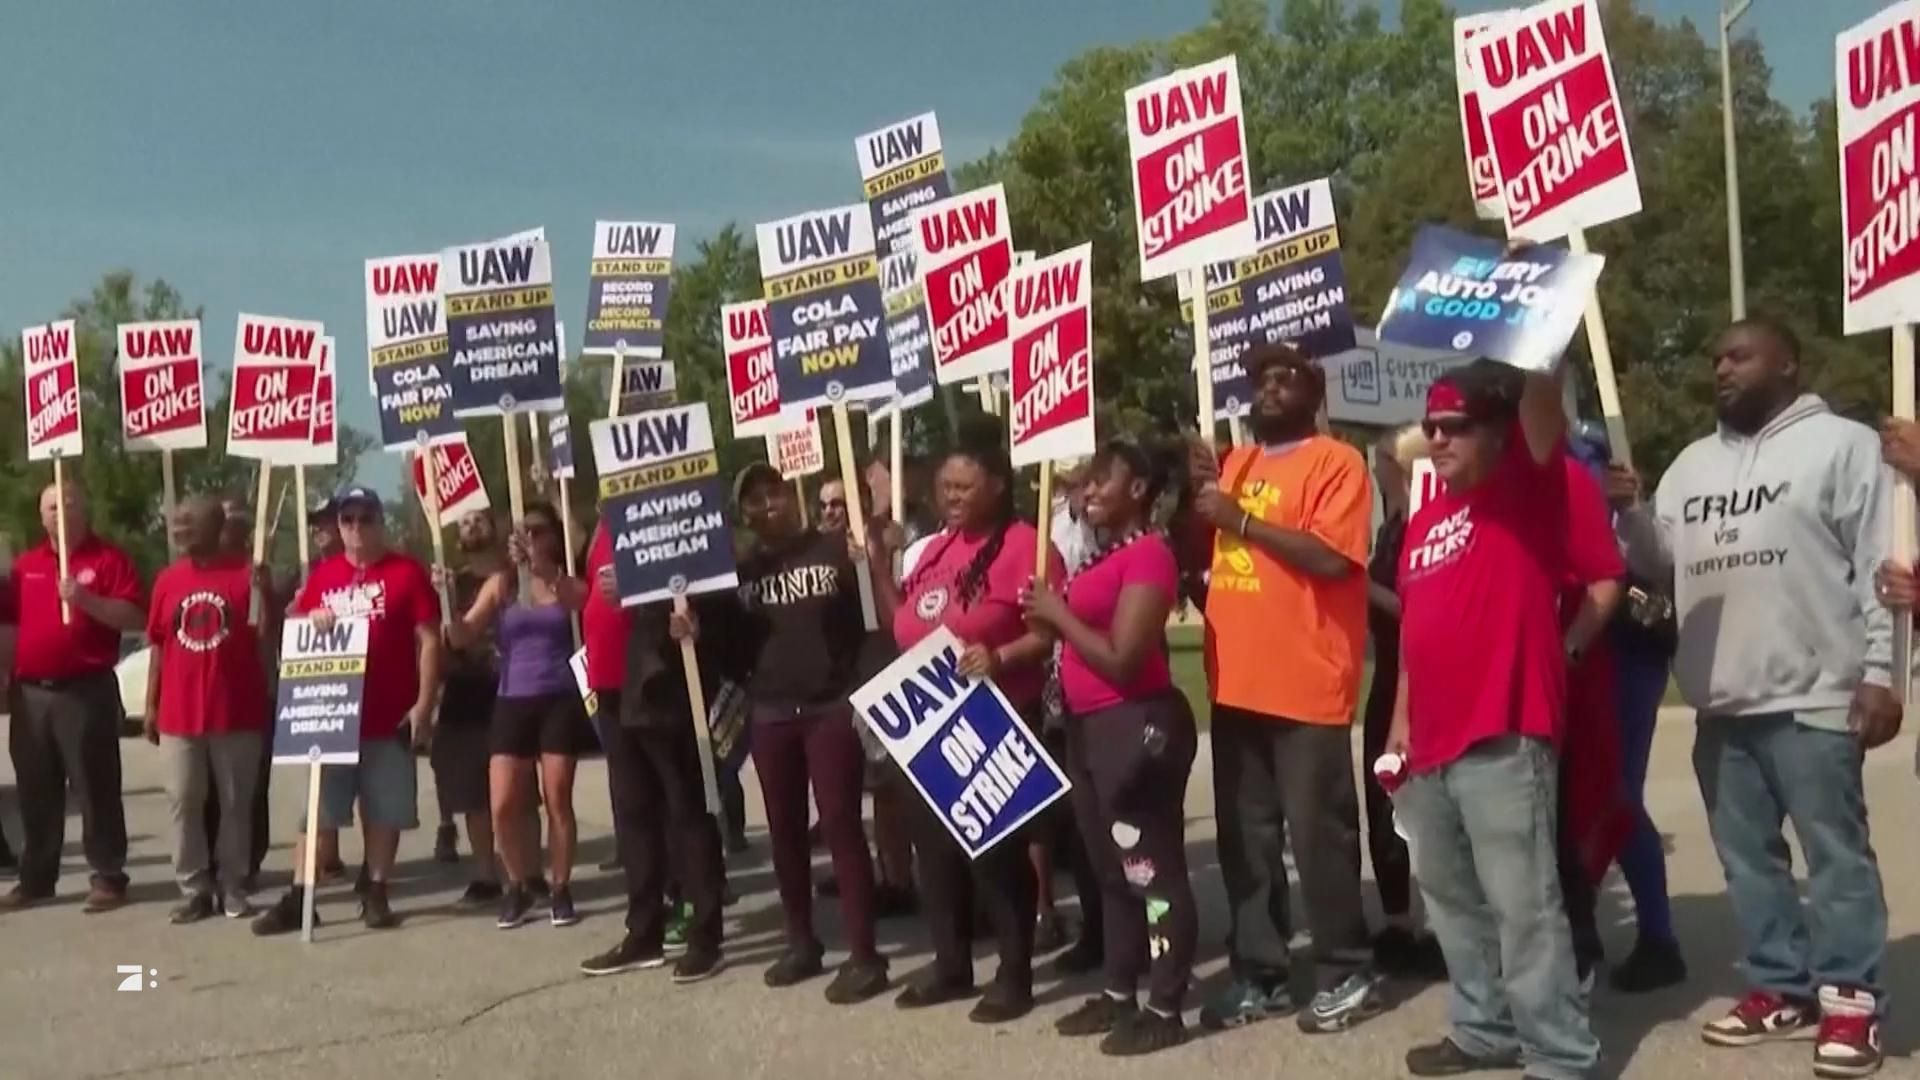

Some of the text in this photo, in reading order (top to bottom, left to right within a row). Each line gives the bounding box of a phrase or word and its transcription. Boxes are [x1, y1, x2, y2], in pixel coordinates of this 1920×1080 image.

[1480, 4, 1586, 89] UAW
[1137, 71, 1227, 136] UAW
[1522, 80, 1570, 150] ON
[869, 120, 922, 169] UAW
[1505, 99, 1620, 222] STRIKE
[1872, 112, 1915, 202] ON
[869, 158, 940, 194] STAND UP
[1166, 134, 1204, 192] ON
[882, 186, 936, 217] SAVING
[1143, 155, 1244, 251] STRIKE
[607, 226, 661, 255] UAW
[776, 212, 851, 265] UAW
[921, 198, 997, 253] UAW
[1850, 177, 1920, 294] STRI
[459, 246, 534, 286] UAW
[595, 262, 666, 273] STAND UP
[1241, 234, 1331, 274] STAND UP
[1452, 256, 1553, 281] EVERY
[373, 262, 438, 295] UAW
[602, 282, 653, 294] RECORD
[771, 260, 870, 298] STAND UP
[949, 254, 983, 306] ON
[1014, 259, 1083, 319] UAW
[1257, 266, 1325, 302] SAVING
[1415, 271, 1557, 306] AUTO JO
[451, 290, 547, 314] STAND UP
[600, 306, 651, 319] RECORD
[601, 293, 653, 305] PROFITS
[792, 295, 859, 326] COLA
[1249, 286, 1345, 332] AMERICAN
[1425, 298, 1501, 321] GOOD
[383, 303, 437, 337] UAW
[465, 319, 537, 341] SAVING
[588, 319, 662, 332] CONTRACTS
[729, 308, 769, 341] UA
[29, 328, 69, 364] UAW
[126, 328, 193, 359] UAW
[244, 323, 315, 360] UAW
[377, 343, 425, 364] STAND
[453, 340, 554, 368] AMERICAN
[777, 317, 881, 359] FAIR PAY
[1029, 322, 1058, 381] ON
[392, 364, 441, 384] COLA
[470, 359, 539, 383] DREAM
[747, 351, 773, 382] ON
[802, 343, 860, 374] NOW
[39, 369, 59, 402] ON
[145, 366, 174, 399] ON
[256, 368, 288, 401] ON
[381, 388, 420, 411] FAIR
[1014, 349, 1088, 441] STRIKE
[30, 386, 77, 444] STRIKE
[127, 383, 200, 434] STRIKE
[232, 392, 312, 438] STRIKE
[399, 404, 442, 424] NOW
[735, 380, 779, 421] STRI
[611, 412, 690, 463] UAW
[438, 453, 474, 500] RIKE
[605, 458, 709, 493] STAND UP
[625, 490, 703, 522] SAVING
[615, 511, 723, 551] AMERICAN
[1715, 528, 1738, 545] VS
[635, 535, 709, 566] DREAM
[297, 623, 353, 653] UAW
[286, 660, 360, 675] STAND UP
[293, 683, 348, 699] SAVING
[867, 645, 971, 741] UAW
[280, 702, 359, 720] AMERICAN
[290, 719, 345, 735] DREAM
[940, 715, 987, 778] ON
[950, 727, 1037, 842] STRIKE
